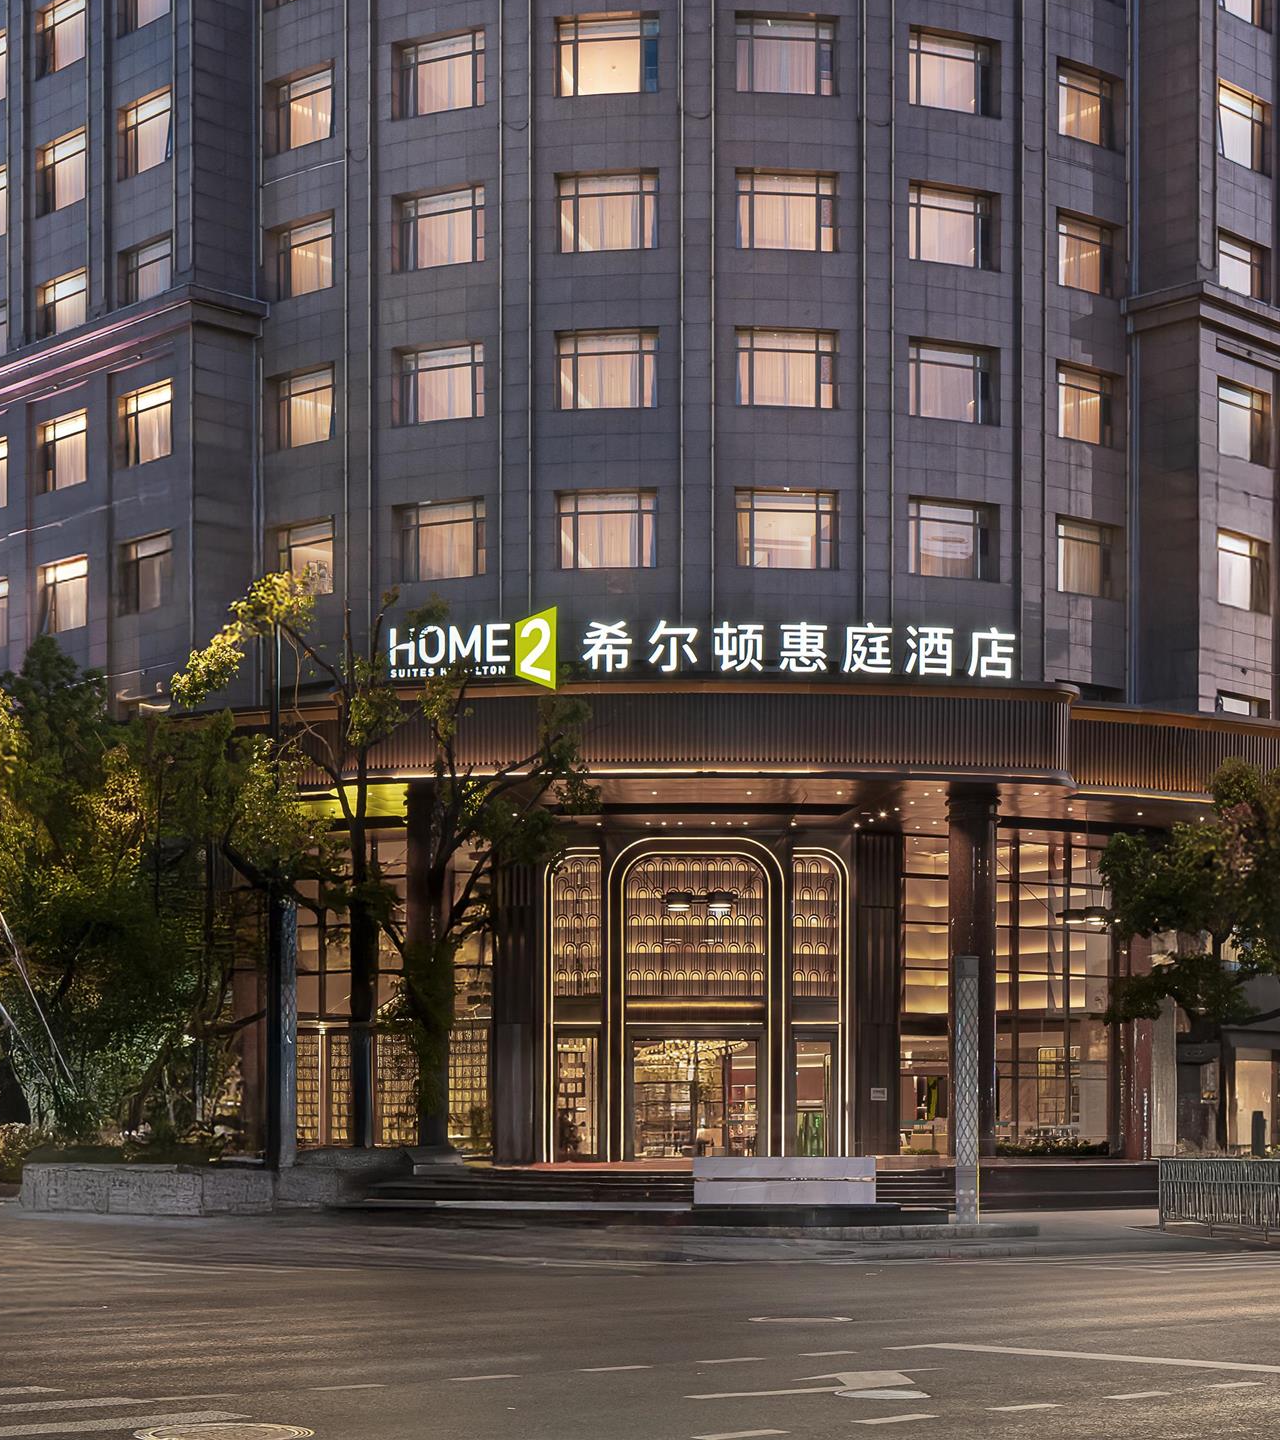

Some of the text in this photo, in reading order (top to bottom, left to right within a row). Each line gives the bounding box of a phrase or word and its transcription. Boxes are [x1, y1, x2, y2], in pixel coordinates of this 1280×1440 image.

[389, 617, 552, 682] HOME 2
[390, 667, 435, 678] SUITES
[582, 619, 1017, 679] 希尔顿惠庭酒店
